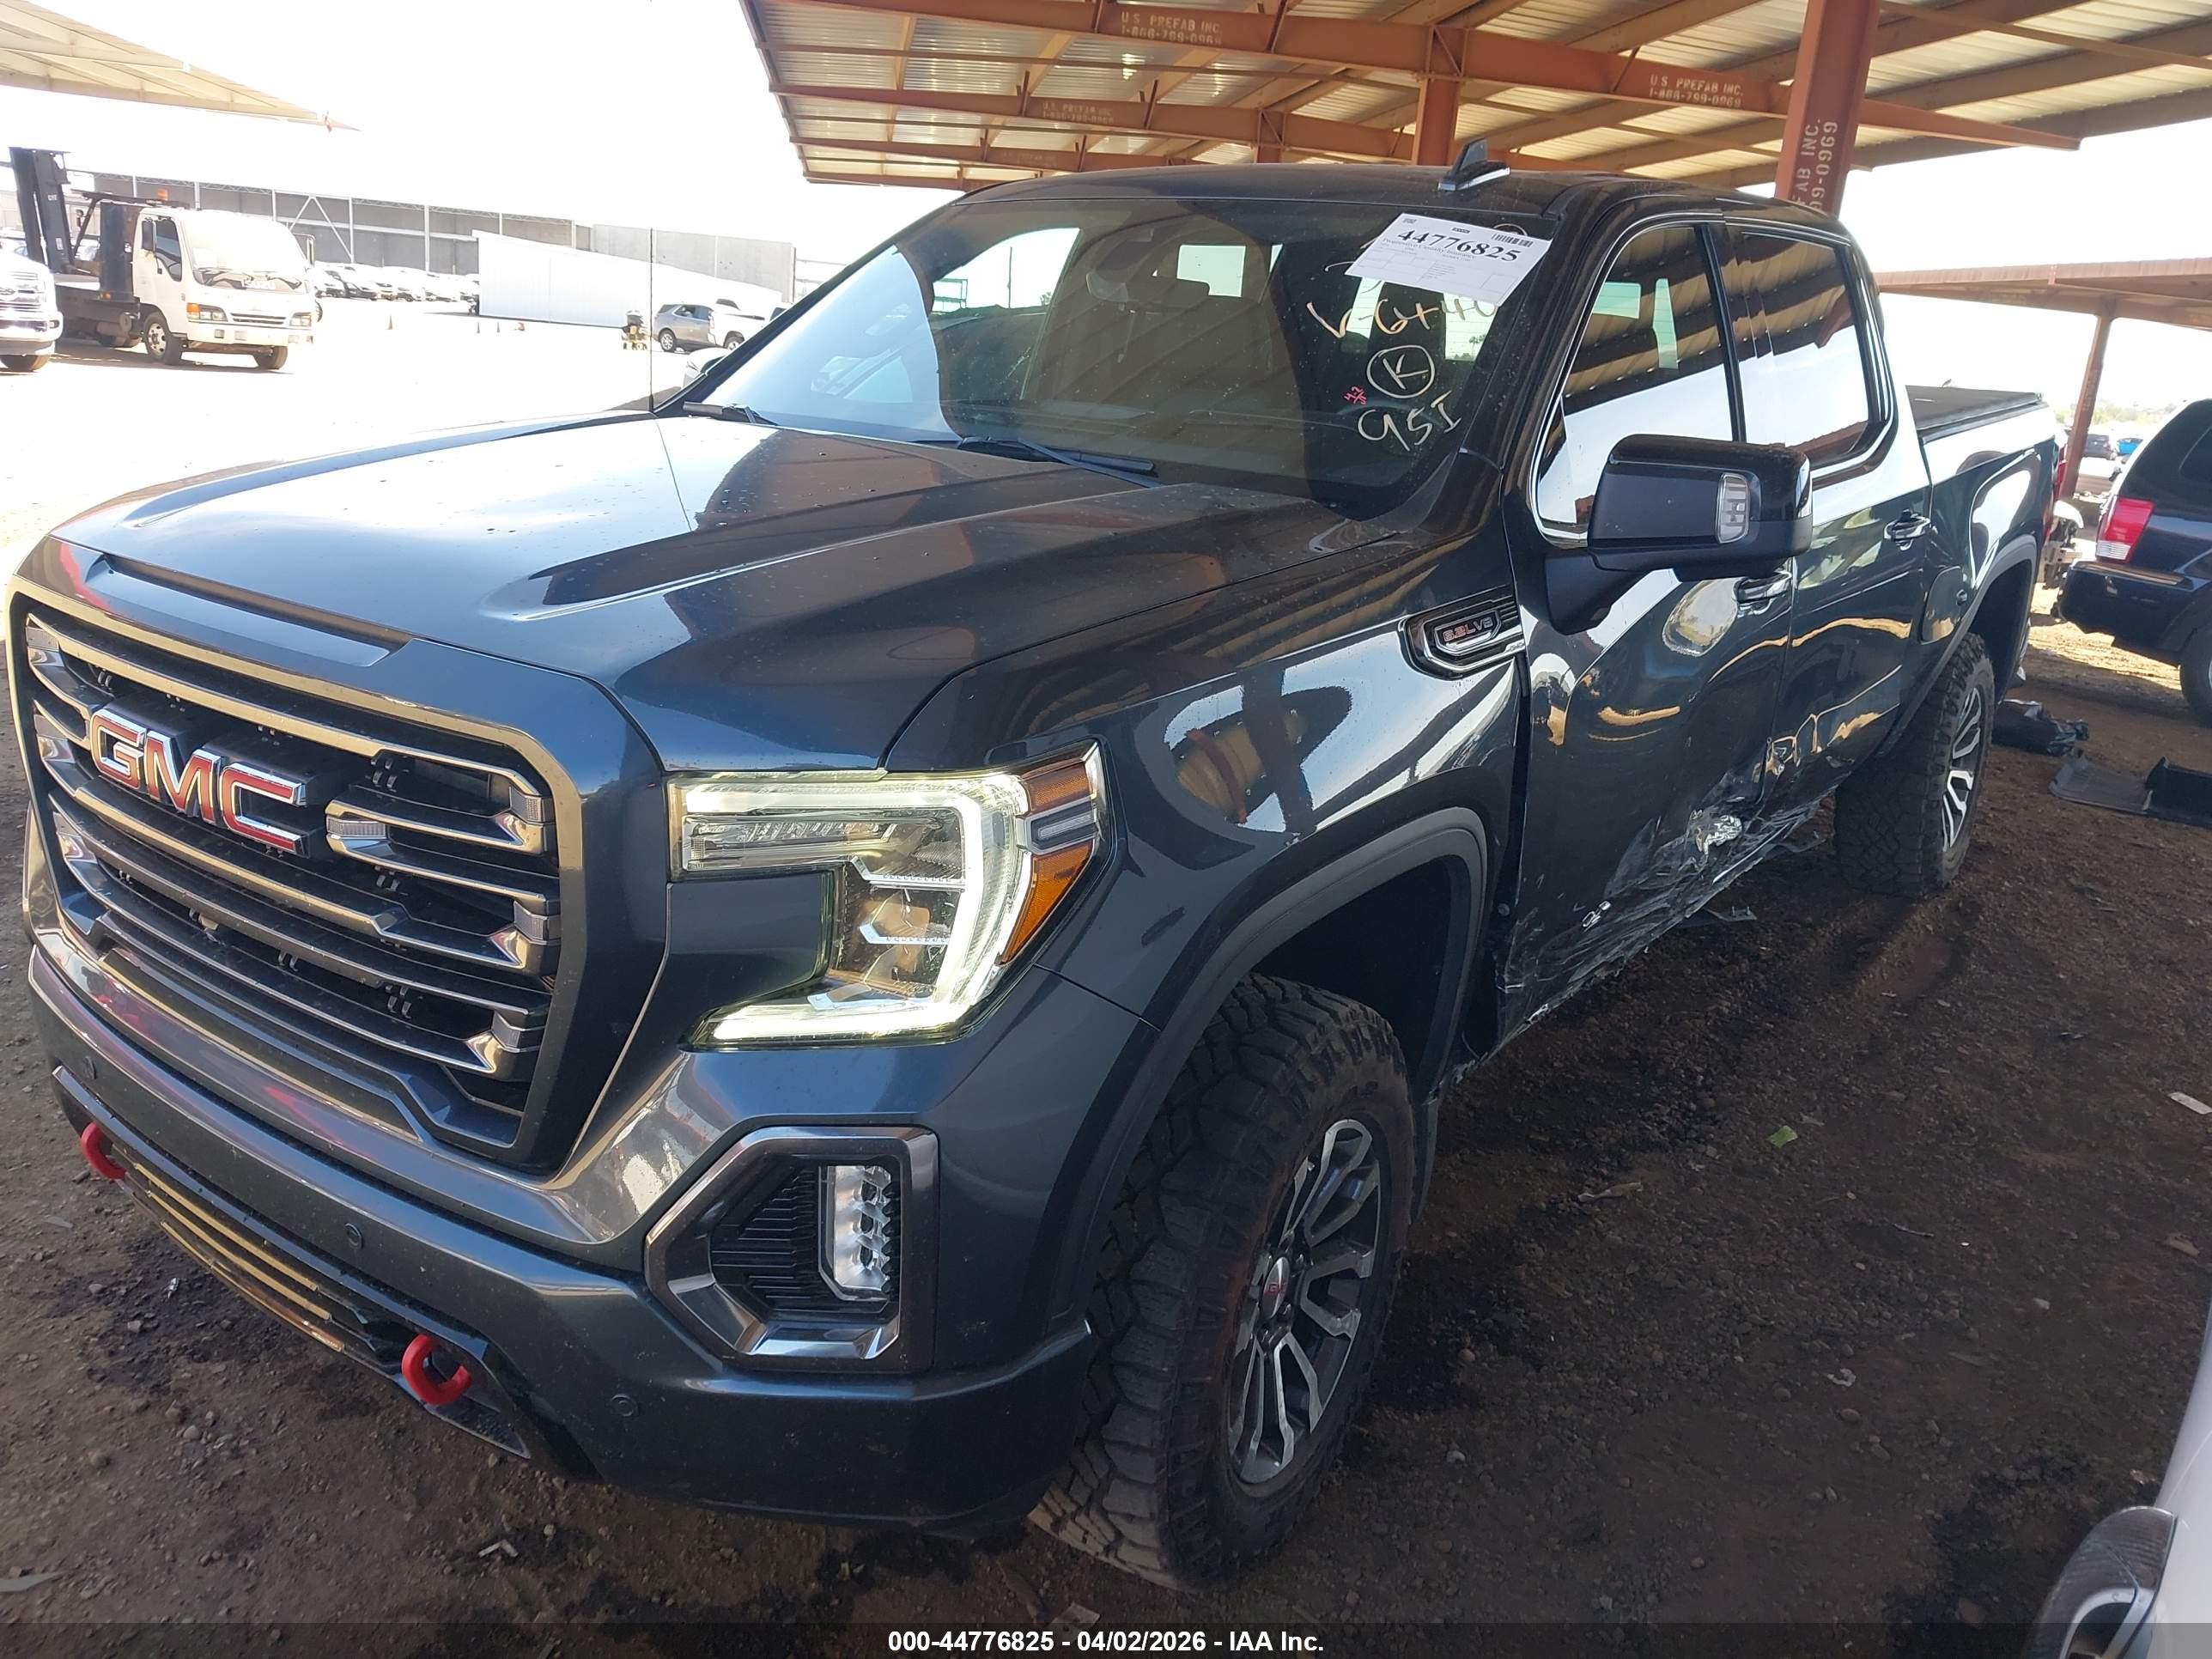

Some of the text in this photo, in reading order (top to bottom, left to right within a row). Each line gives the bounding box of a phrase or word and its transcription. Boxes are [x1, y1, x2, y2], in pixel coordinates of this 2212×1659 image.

[1150, 14, 1196, 33] PREFAB
[1675, 77, 1719, 94] PREFAB
[1800, 118, 1821, 156] INC.
[1397, 229, 1522, 262] 44776825
[1382, 353, 1430, 390] K
[89, 707, 307, 856] GMC
